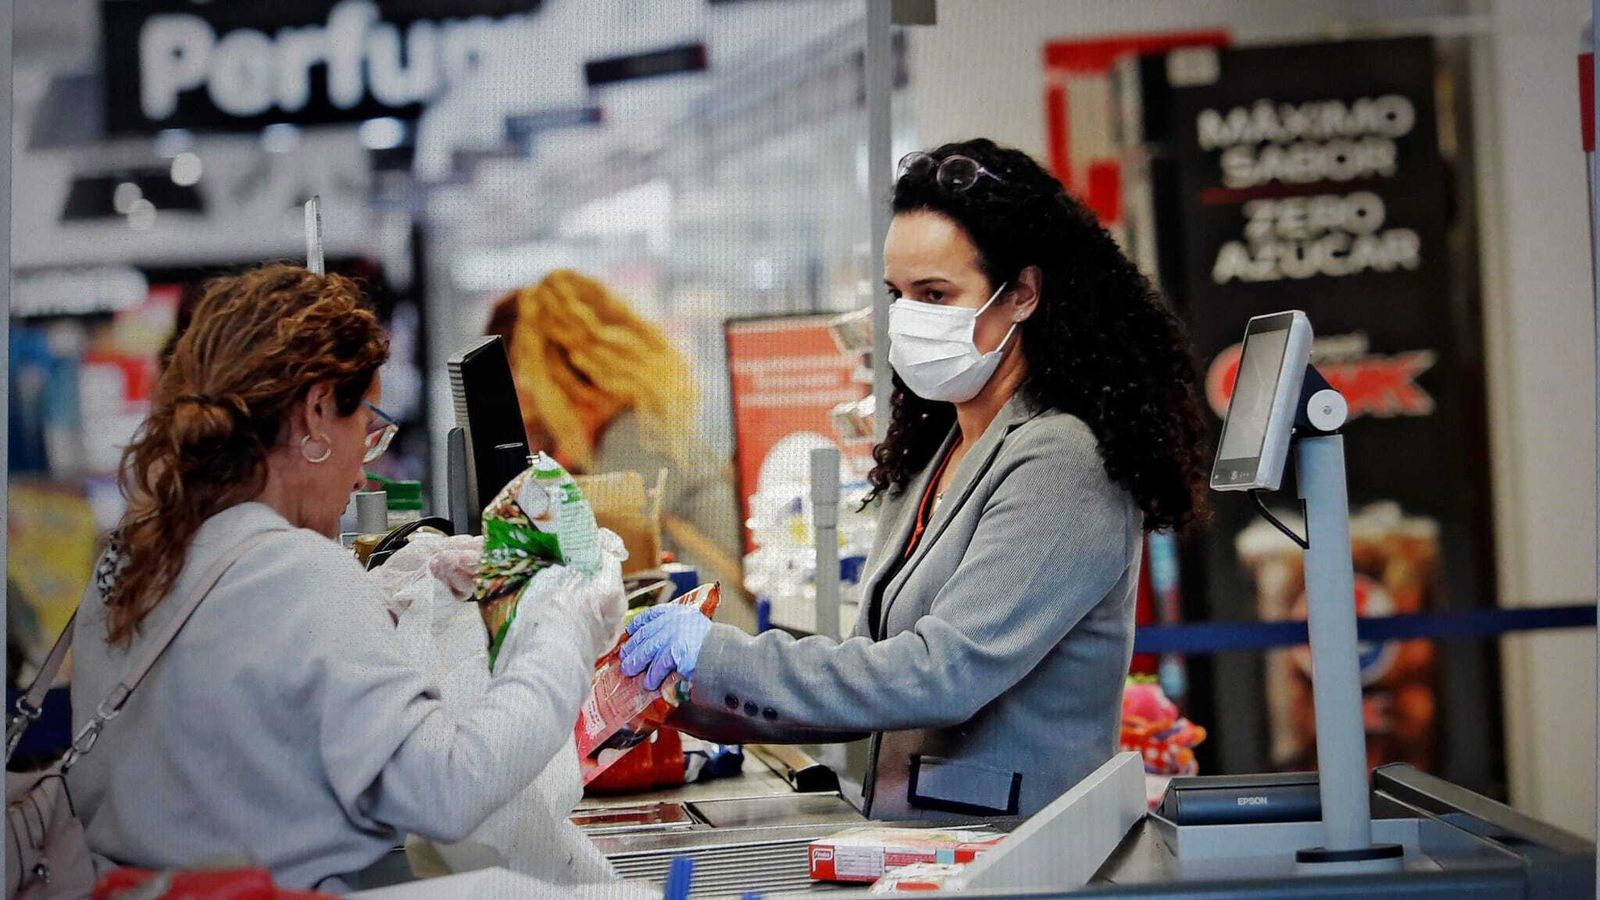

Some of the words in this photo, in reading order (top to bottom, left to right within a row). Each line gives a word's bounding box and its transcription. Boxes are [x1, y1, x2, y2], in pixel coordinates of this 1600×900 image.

[1221, 139, 1396, 187] SABOR
[1245, 191, 1386, 238] ZERO
[1237, 796, 1268, 806] EPSON
